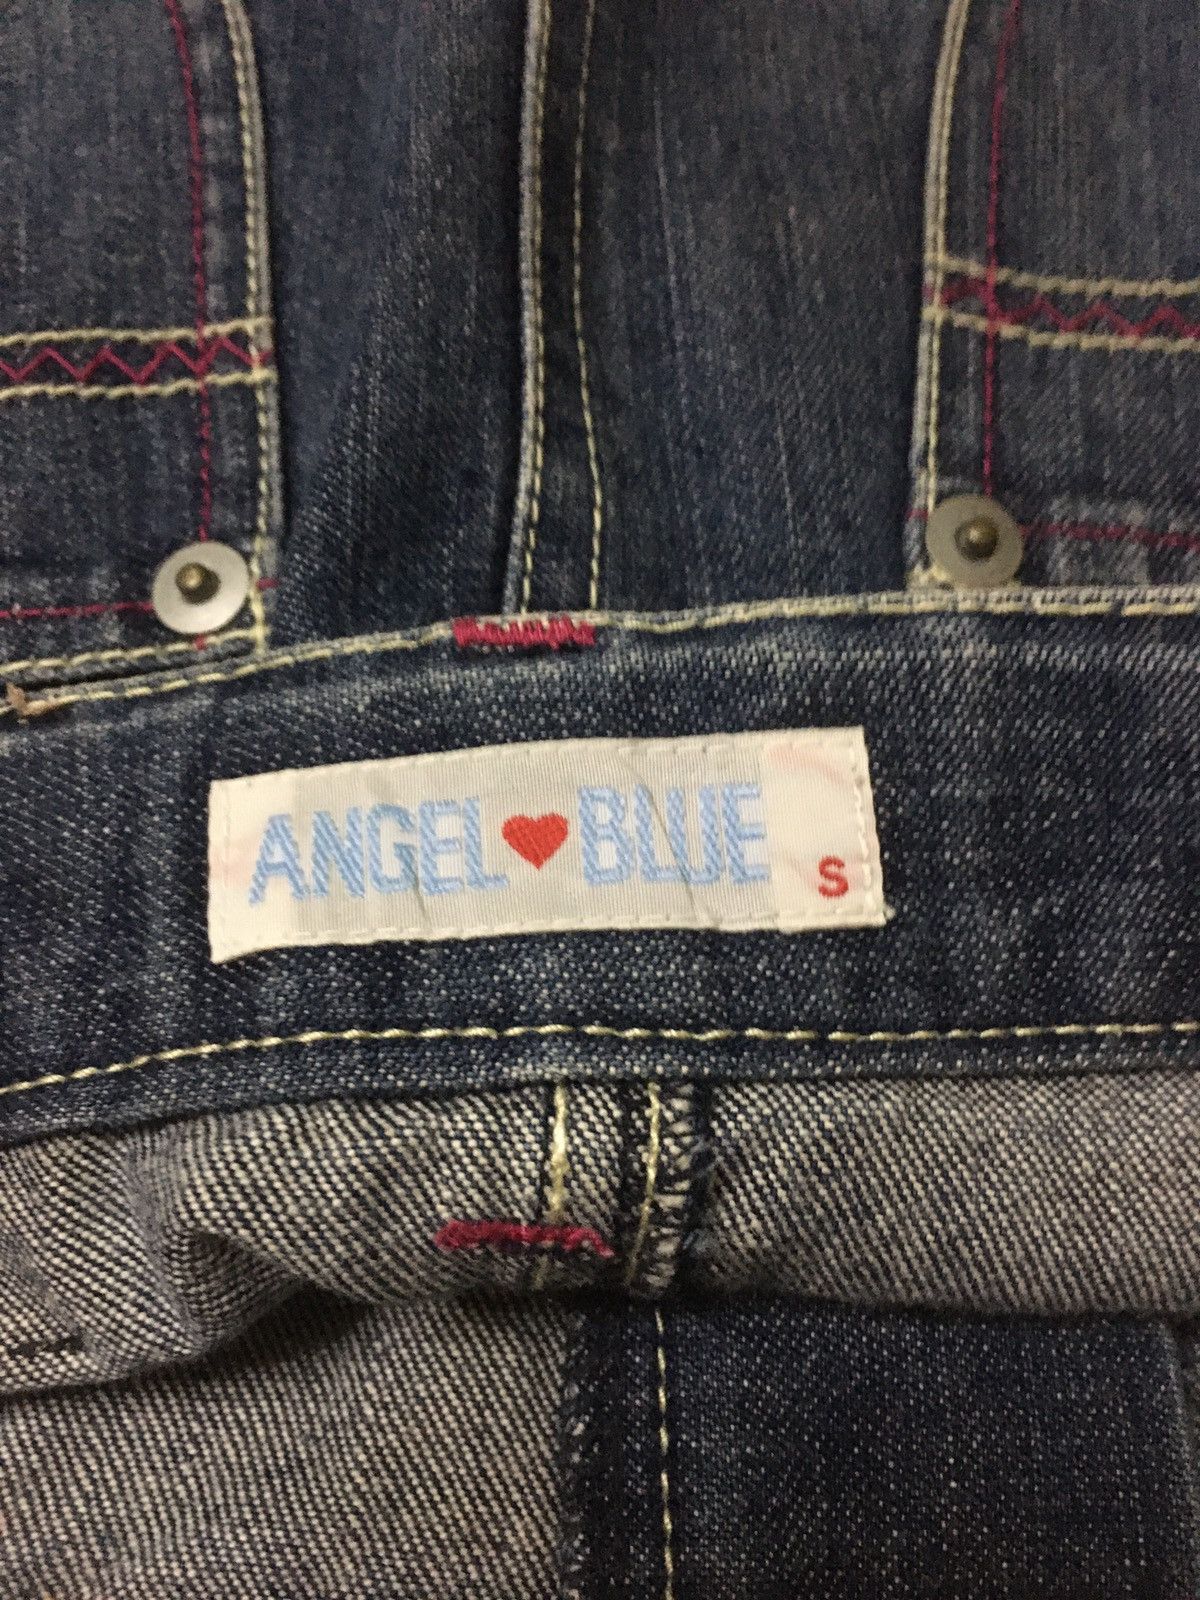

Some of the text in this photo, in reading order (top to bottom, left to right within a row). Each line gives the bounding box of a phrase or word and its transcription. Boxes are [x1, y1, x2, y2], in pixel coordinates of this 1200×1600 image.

[248, 783, 770, 905] ANGEL BLUE
[817, 856, 849, 898] S
